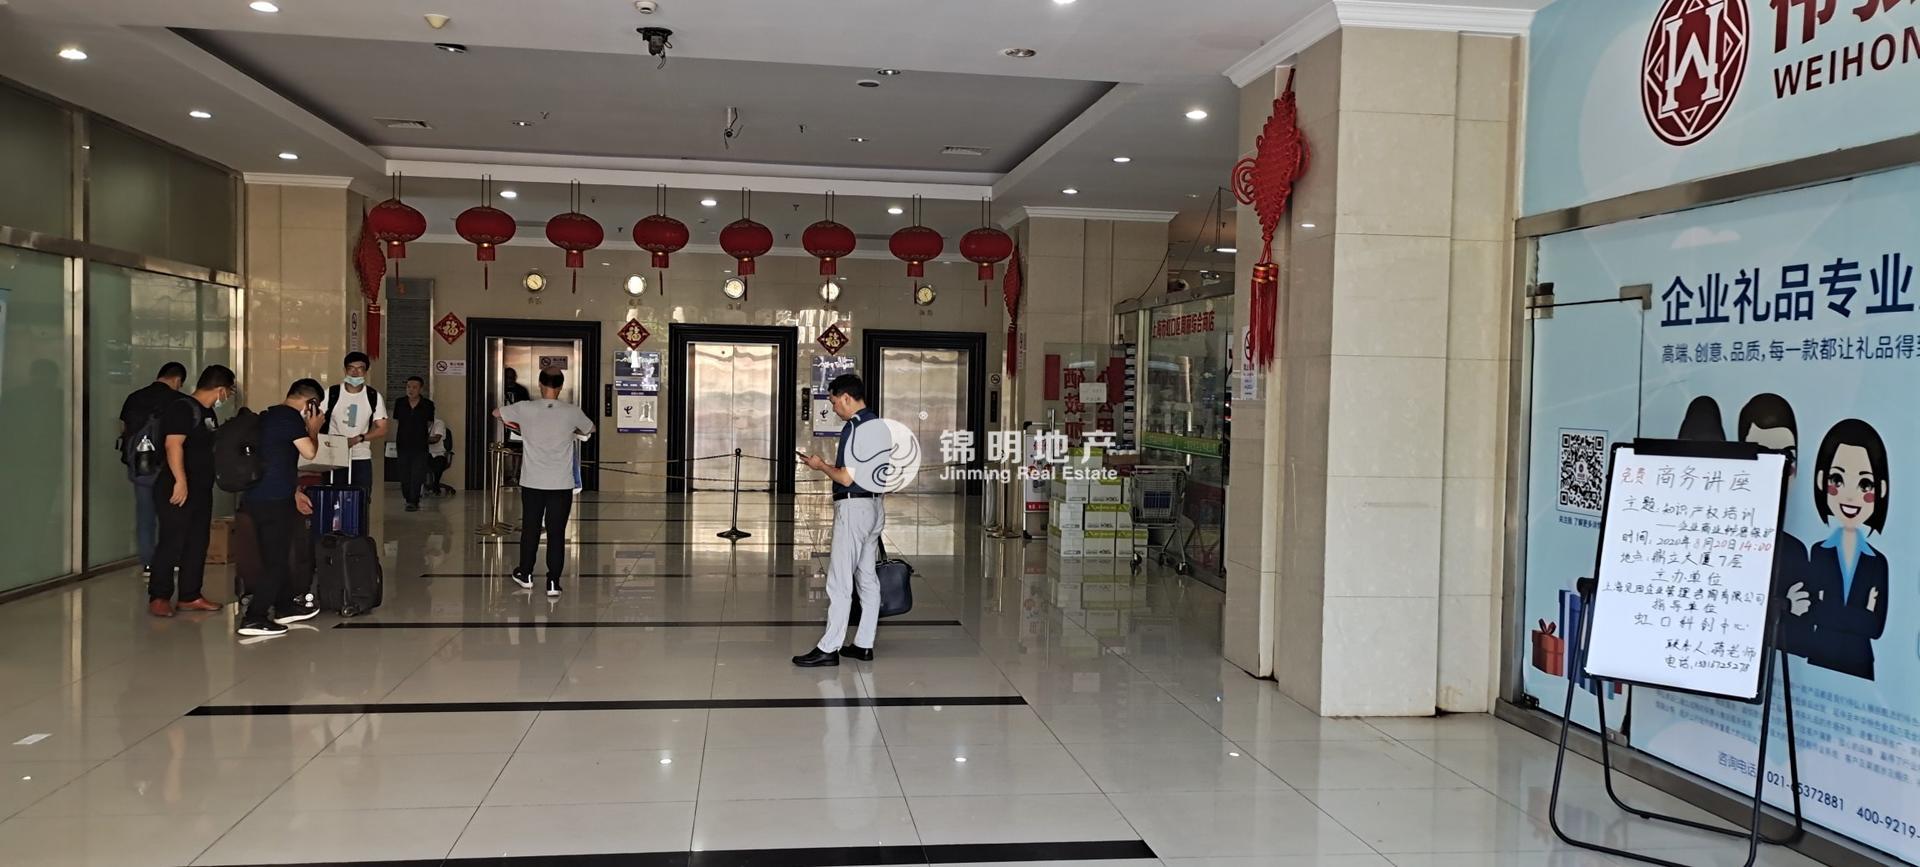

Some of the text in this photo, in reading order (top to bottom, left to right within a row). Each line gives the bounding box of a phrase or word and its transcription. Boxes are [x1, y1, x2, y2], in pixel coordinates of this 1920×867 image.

[1660, 252, 1915, 328] 企业礼品专业
[1620, 465, 1753, 493] 免费 商务讲座
[1651, 570, 1723, 588] 主办单位
[1651, 598, 1719, 615] 指导单位
